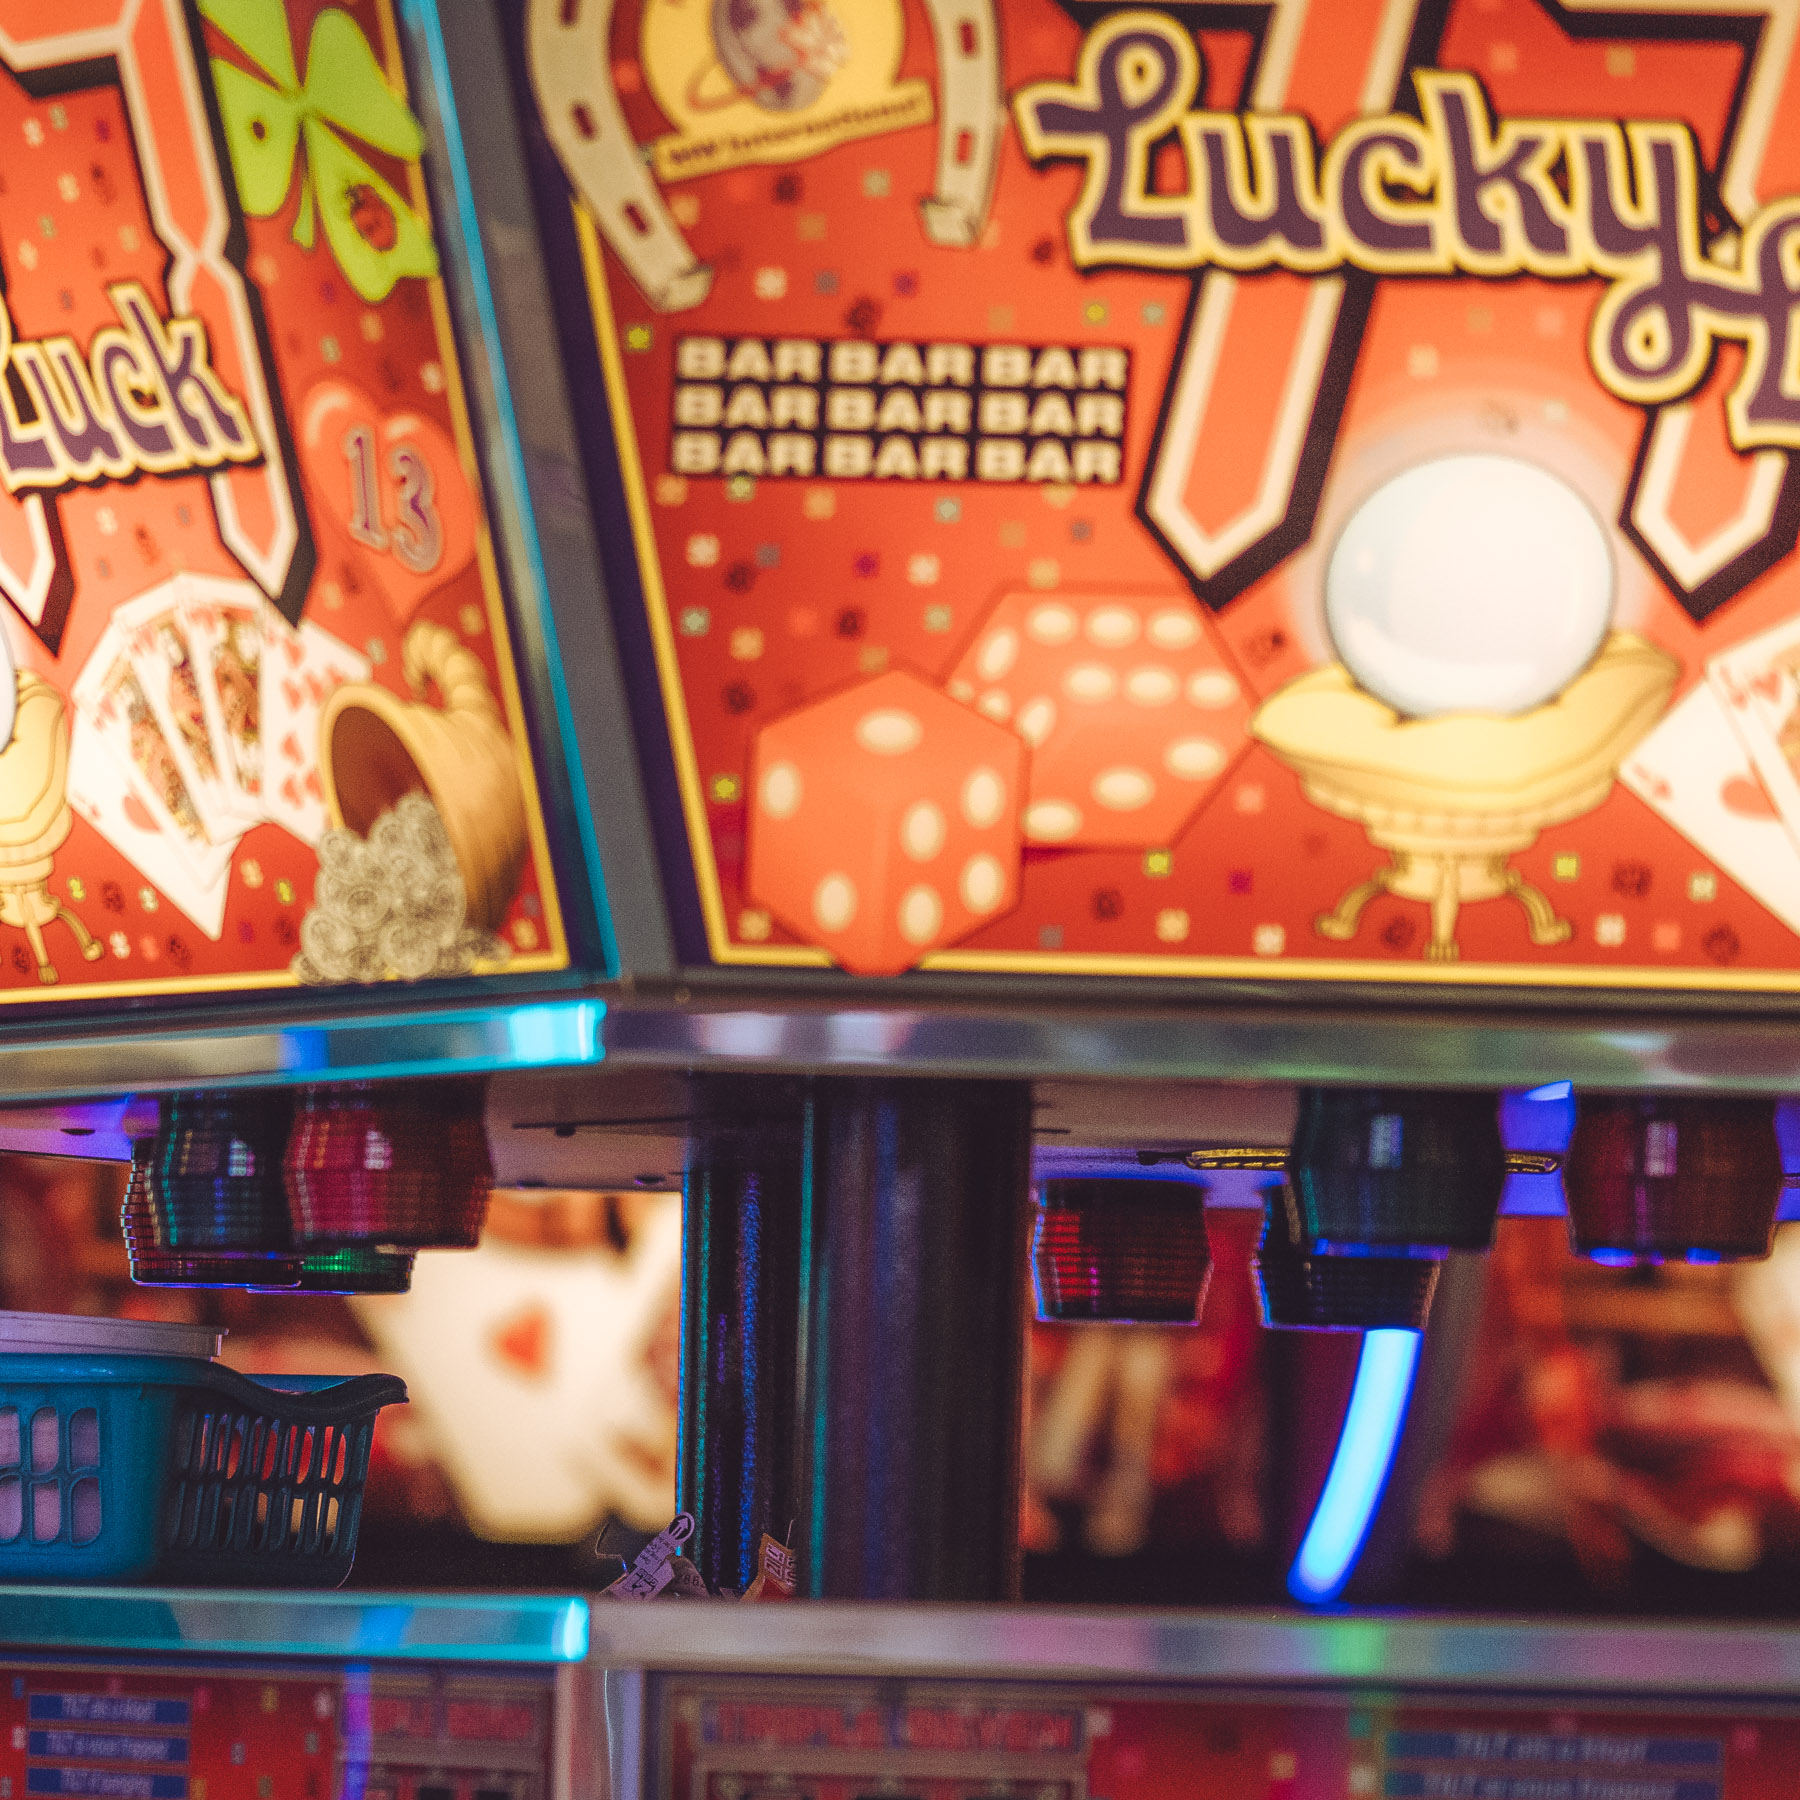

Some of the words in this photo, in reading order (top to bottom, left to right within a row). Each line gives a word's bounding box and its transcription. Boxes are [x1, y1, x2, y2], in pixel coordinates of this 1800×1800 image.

[1015, 10, 1735, 405] Lucky
[678, 335, 823, 384] BAR
[829, 340, 975, 388] BAR
[980, 345, 1127, 390] BAR
[675, 382, 820, 429] BAR
[825, 386, 973, 433] BAR
[977, 391, 1126, 437] BAR
[672, 429, 818, 476] BAR
[823, 433, 970, 480] BAR
[974, 437, 1122, 484] BAR
[342, 424, 443, 574] 13
